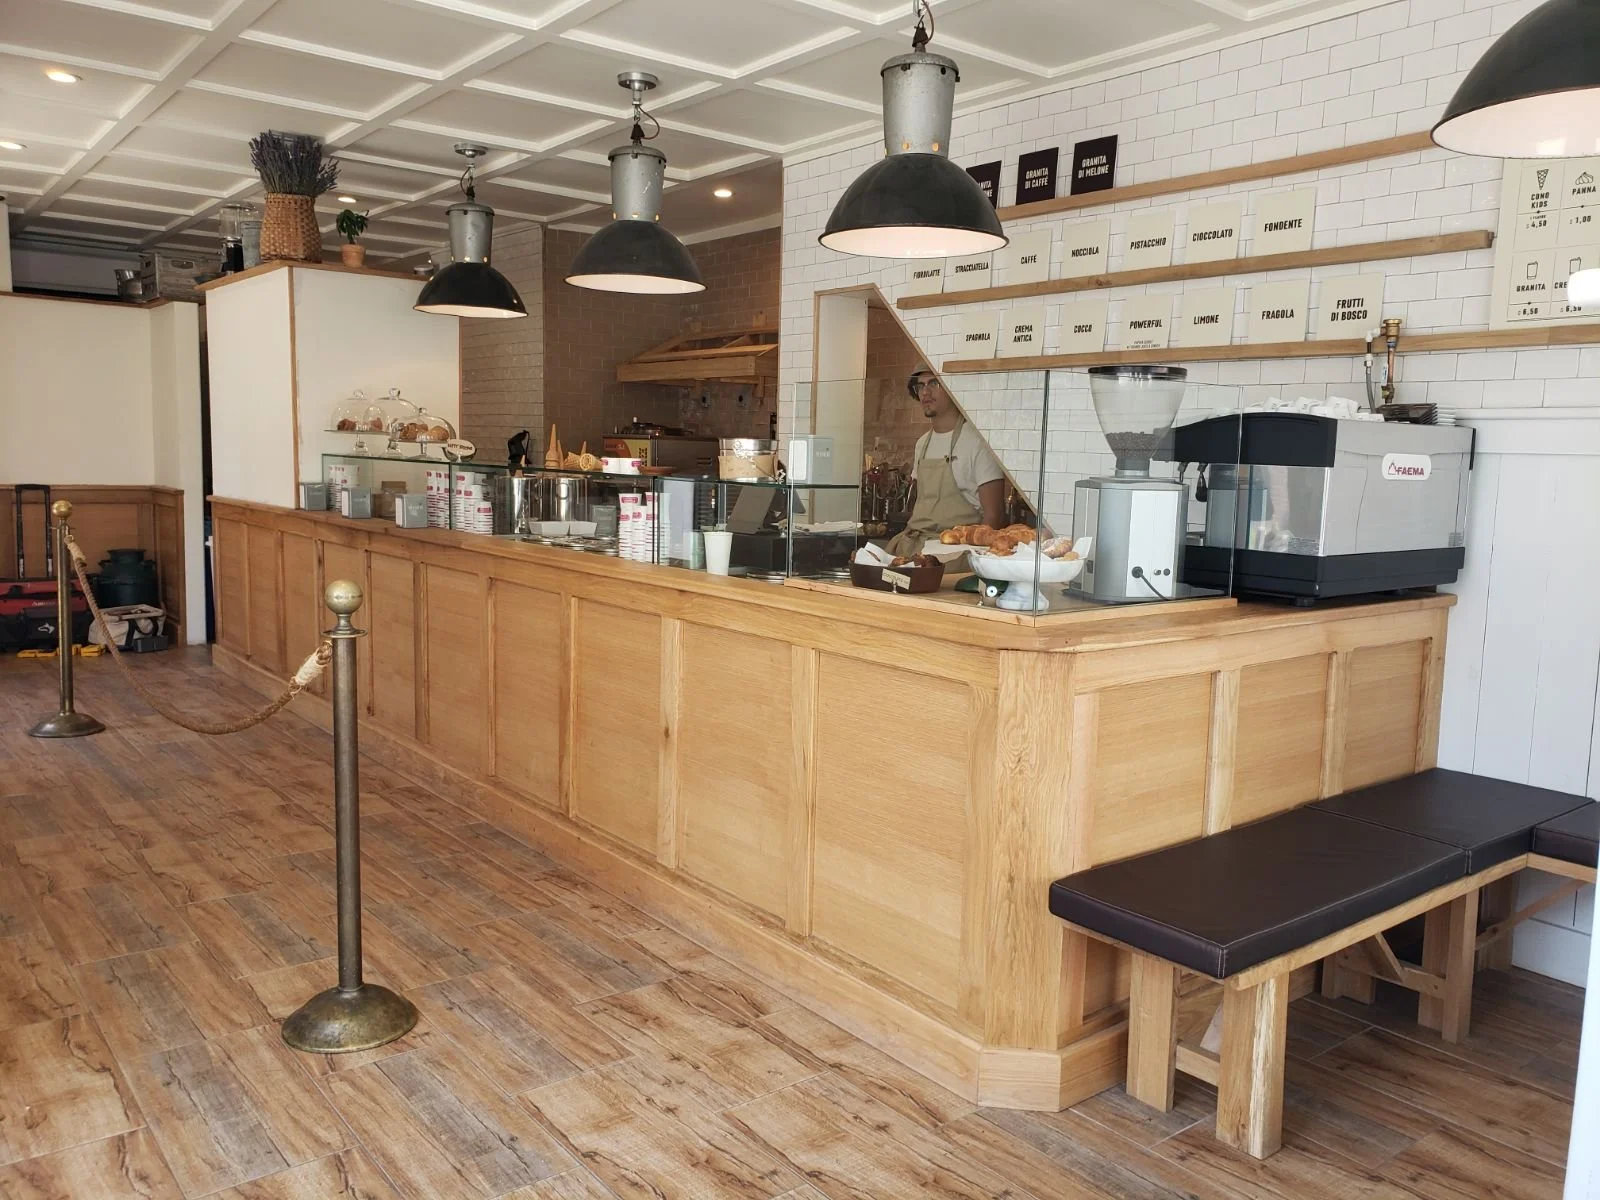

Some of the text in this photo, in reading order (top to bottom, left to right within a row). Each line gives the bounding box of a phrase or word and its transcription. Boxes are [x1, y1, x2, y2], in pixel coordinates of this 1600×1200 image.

[1082, 155, 1107, 168] GRANITA
[1026, 167, 1048, 179] GRANITA
[1078, 165, 1109, 178] DI MELONE
[1025, 181, 1031, 189] DI
[1572, 186, 1596, 195] PANNA
[1531, 192, 1549, 200] CONO
[1264, 218, 1303, 232] FONDENTE
[1192, 228, 1233, 242] CIOCCOLATO
[1130, 237, 1167, 250] PISTACCHIO
[1071, 246, 1099, 257] NOCCIOLA
[955, 261, 989, 273] STRACCIATELLA
[1516, 283, 1546, 292] GRANITA
[1336, 298, 1364, 309] FRUTTI
[1193, 315, 1219, 325] LIMONE
[1261, 309, 1295, 320] FRAGOLA
[1331, 310, 1368, 322] DI BOSCO
[1014, 325, 1033, 334] CREMA
[1073, 324, 1092, 333] COCCO
[1130, 319, 1162, 329] POWERFUL
[1013, 334, 1032, 343] ANTICA
[1396, 466, 1425, 476] FAEMA
